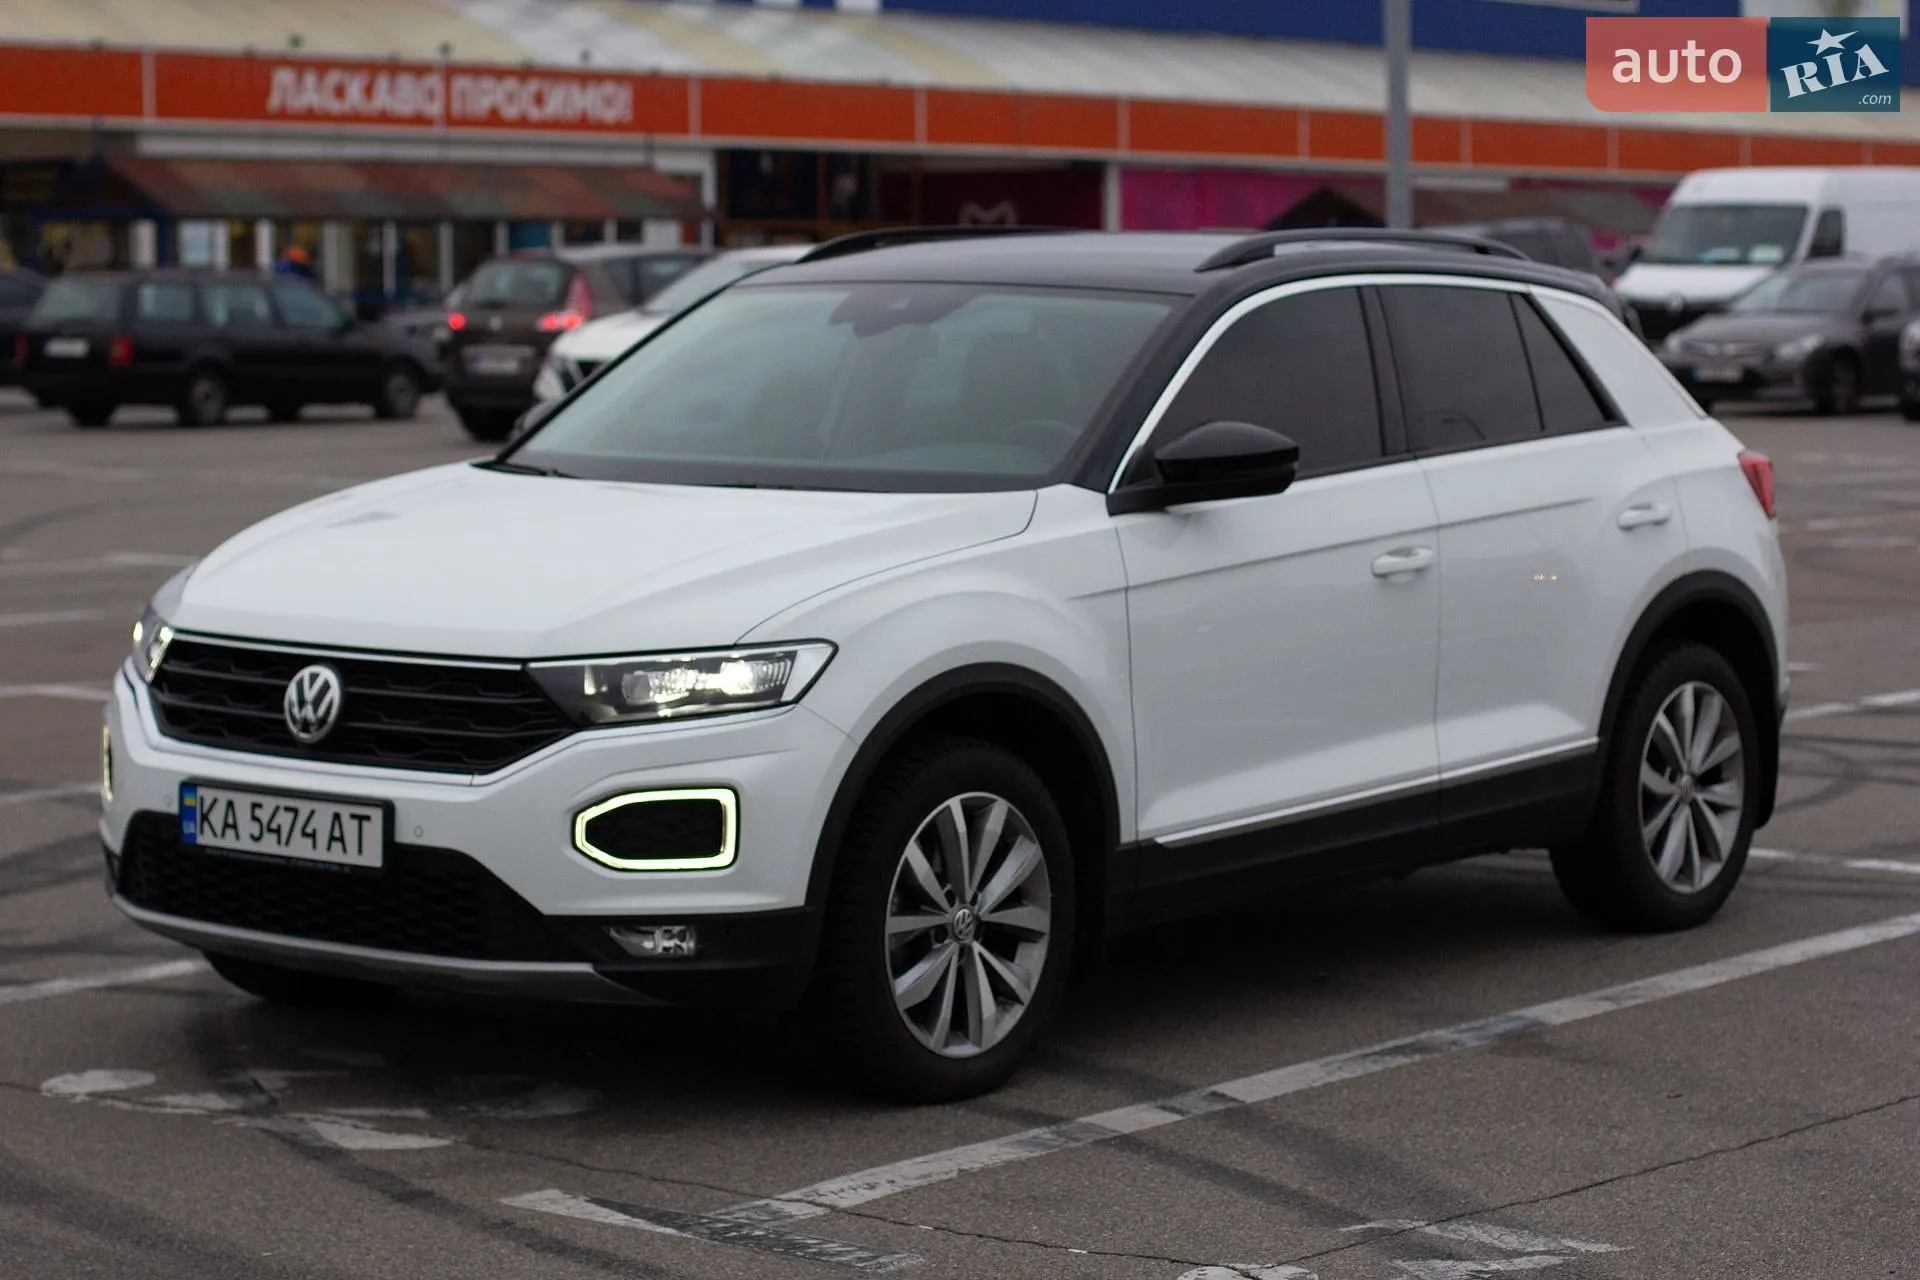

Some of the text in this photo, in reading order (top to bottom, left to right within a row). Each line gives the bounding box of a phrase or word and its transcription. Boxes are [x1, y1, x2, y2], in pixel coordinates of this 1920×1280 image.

[267, 66, 634, 124] ЛАСКАВО ПРОСИМО!
[200, 796, 371, 855] KA 5474 AT
